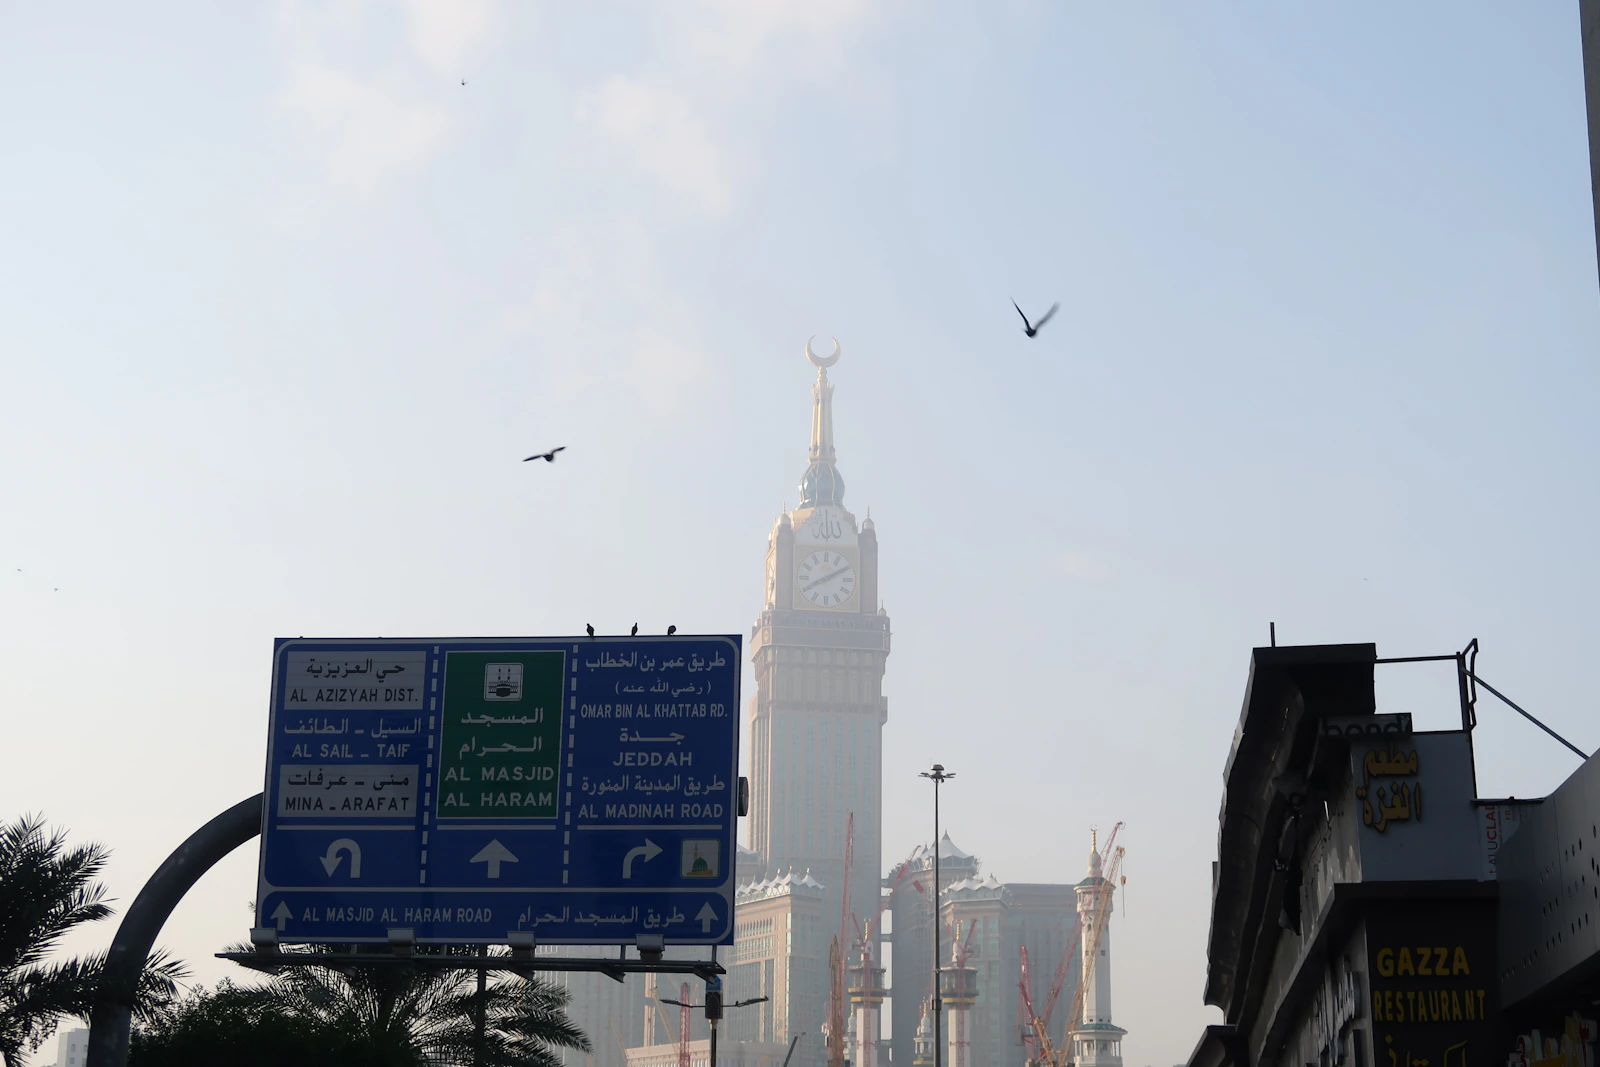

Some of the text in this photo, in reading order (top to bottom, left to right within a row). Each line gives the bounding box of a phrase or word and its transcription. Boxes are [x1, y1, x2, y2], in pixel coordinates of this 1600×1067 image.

[306, 657, 405, 683] حي العزيزية
[585, 650, 726, 673] طريق عمر بن الخطاب
[290, 688, 418, 702] AL AZIZYAH DIST.
[460, 706, 544, 728] المسجد
[580, 703, 728, 718] OMAR BIN AL KHATTAB RD.
[284, 716, 349, 735] الطائف
[370, 716, 422, 739] السيل
[619, 727, 685, 746] جدة
[291, 744, 312, 758] AL
[320, 743, 354, 758] SAIL
[376, 743, 411, 758] TAIF
[458, 735, 543, 761] الحرام
[612, 751, 692, 767] JEDDAH
[1363, 741, 1419, 788] مطعم
[288, 767, 348, 790] عرفات
[373, 773, 409, 791] منى
[444, 766, 555, 781] AL MASJID
[581, 773, 726, 797] طريق المدينة المنورة
[285, 797, 323, 811] MINA
[341, 796, 410, 811] ARAFAT
[443, 792, 553, 807] AL HARAM
[578, 803, 724, 819] AL MADINAH ROAD
[302, 907, 493, 923] AL MASJID AL HARAM ROAD
[517, 905, 686, 930] طريق المسجد الحرام
[1376, 946, 1472, 977] GAZZA
[1373, 989, 1486, 1023] RESTAURANT
